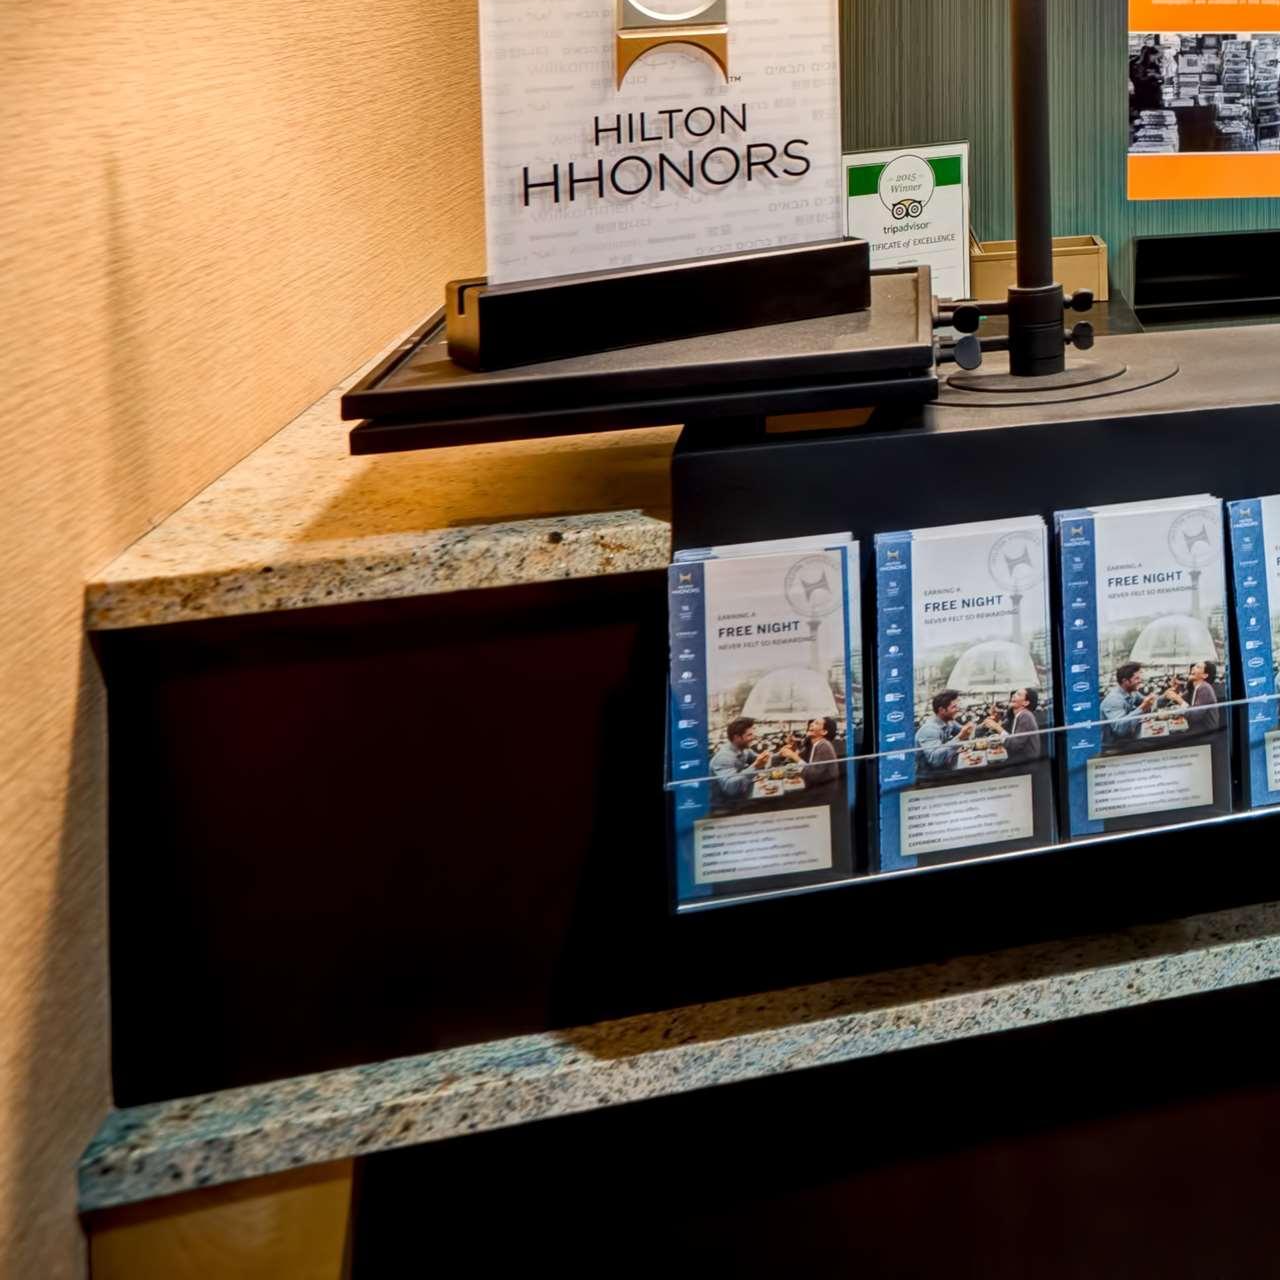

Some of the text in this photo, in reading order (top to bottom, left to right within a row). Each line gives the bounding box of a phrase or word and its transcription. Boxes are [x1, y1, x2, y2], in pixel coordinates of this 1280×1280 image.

[594, 103, 747, 146] HILTON
[523, 139, 811, 206] HHONORS
[895, 173, 917, 182] 2015
[890, 183, 922, 194] Winner
[883, 221, 930, 235] tripadvisor
[870, 234, 956, 252] TIFICATE of EXCELLENCE
[1107, 570, 1183, 588] FREE NIGHT
[1108, 592, 1129, 600] NEVER
[1130, 590, 1145, 598] FELT
[924, 594, 1004, 613] FREE NIGHT
[924, 617, 947, 625] NEVER
[948, 615, 964, 623] FELT
[718, 620, 800, 638] FREE NIGHT
[718, 642, 742, 651] NEVER
[743, 640, 760, 649] FELT
